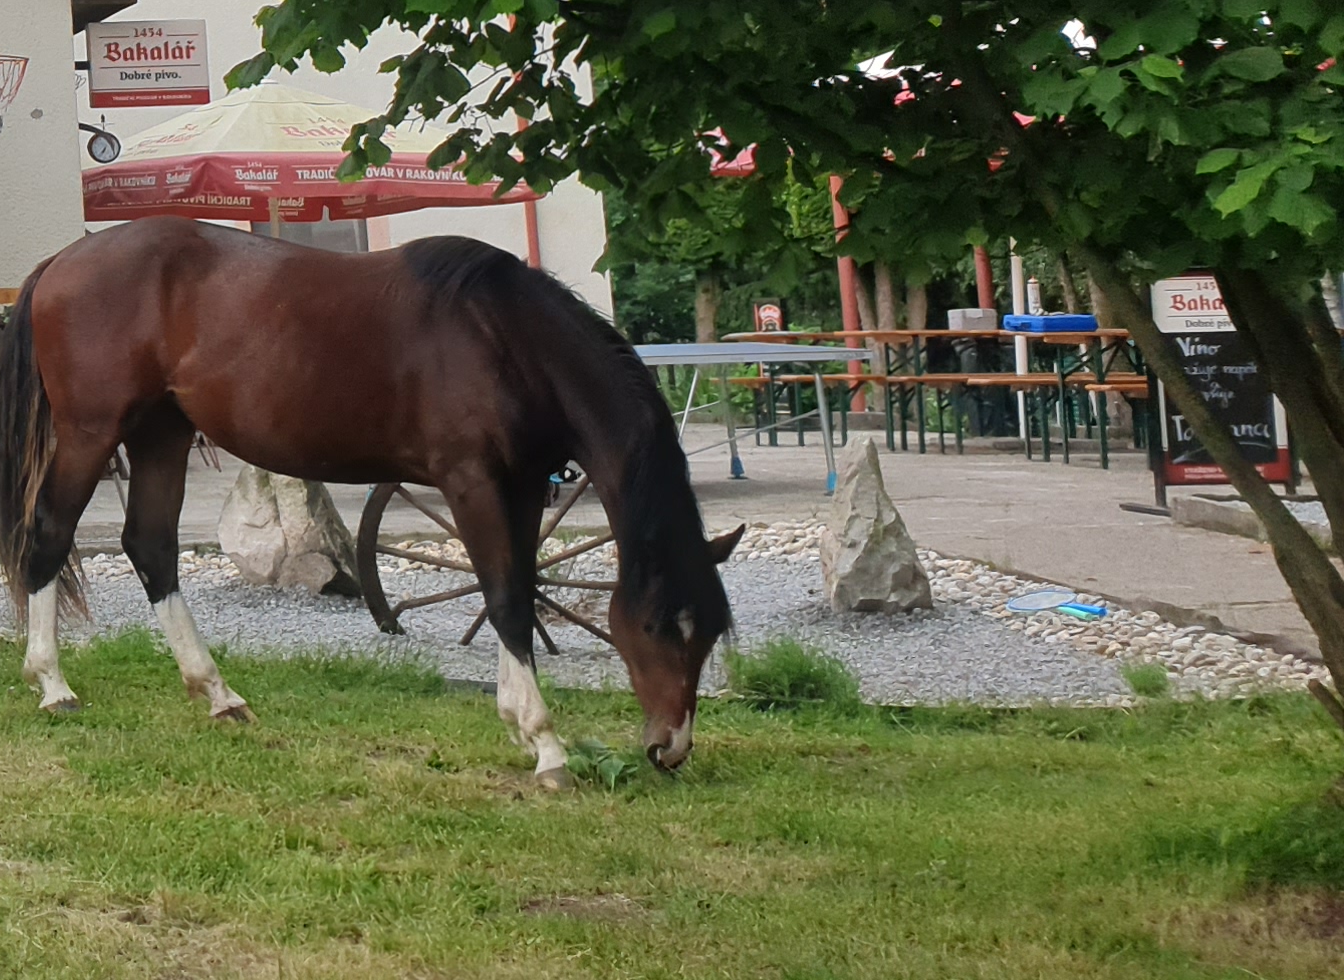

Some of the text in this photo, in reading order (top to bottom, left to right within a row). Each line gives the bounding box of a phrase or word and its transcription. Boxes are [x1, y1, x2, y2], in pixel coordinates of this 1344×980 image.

[133, 27, 163, 38] 1454
[103, 40, 196, 62] Bakalář
[119, 69, 182, 82] Dobré pivo.
[296, 166, 335, 180] TRADIČ
[365, 166, 395, 178] OVAR
[395, 167, 405, 179] V
[1196, 282, 1216, 291] 145
[1169, 293, 1225, 311] Baka
[1216, 318, 1233, 329] piv
